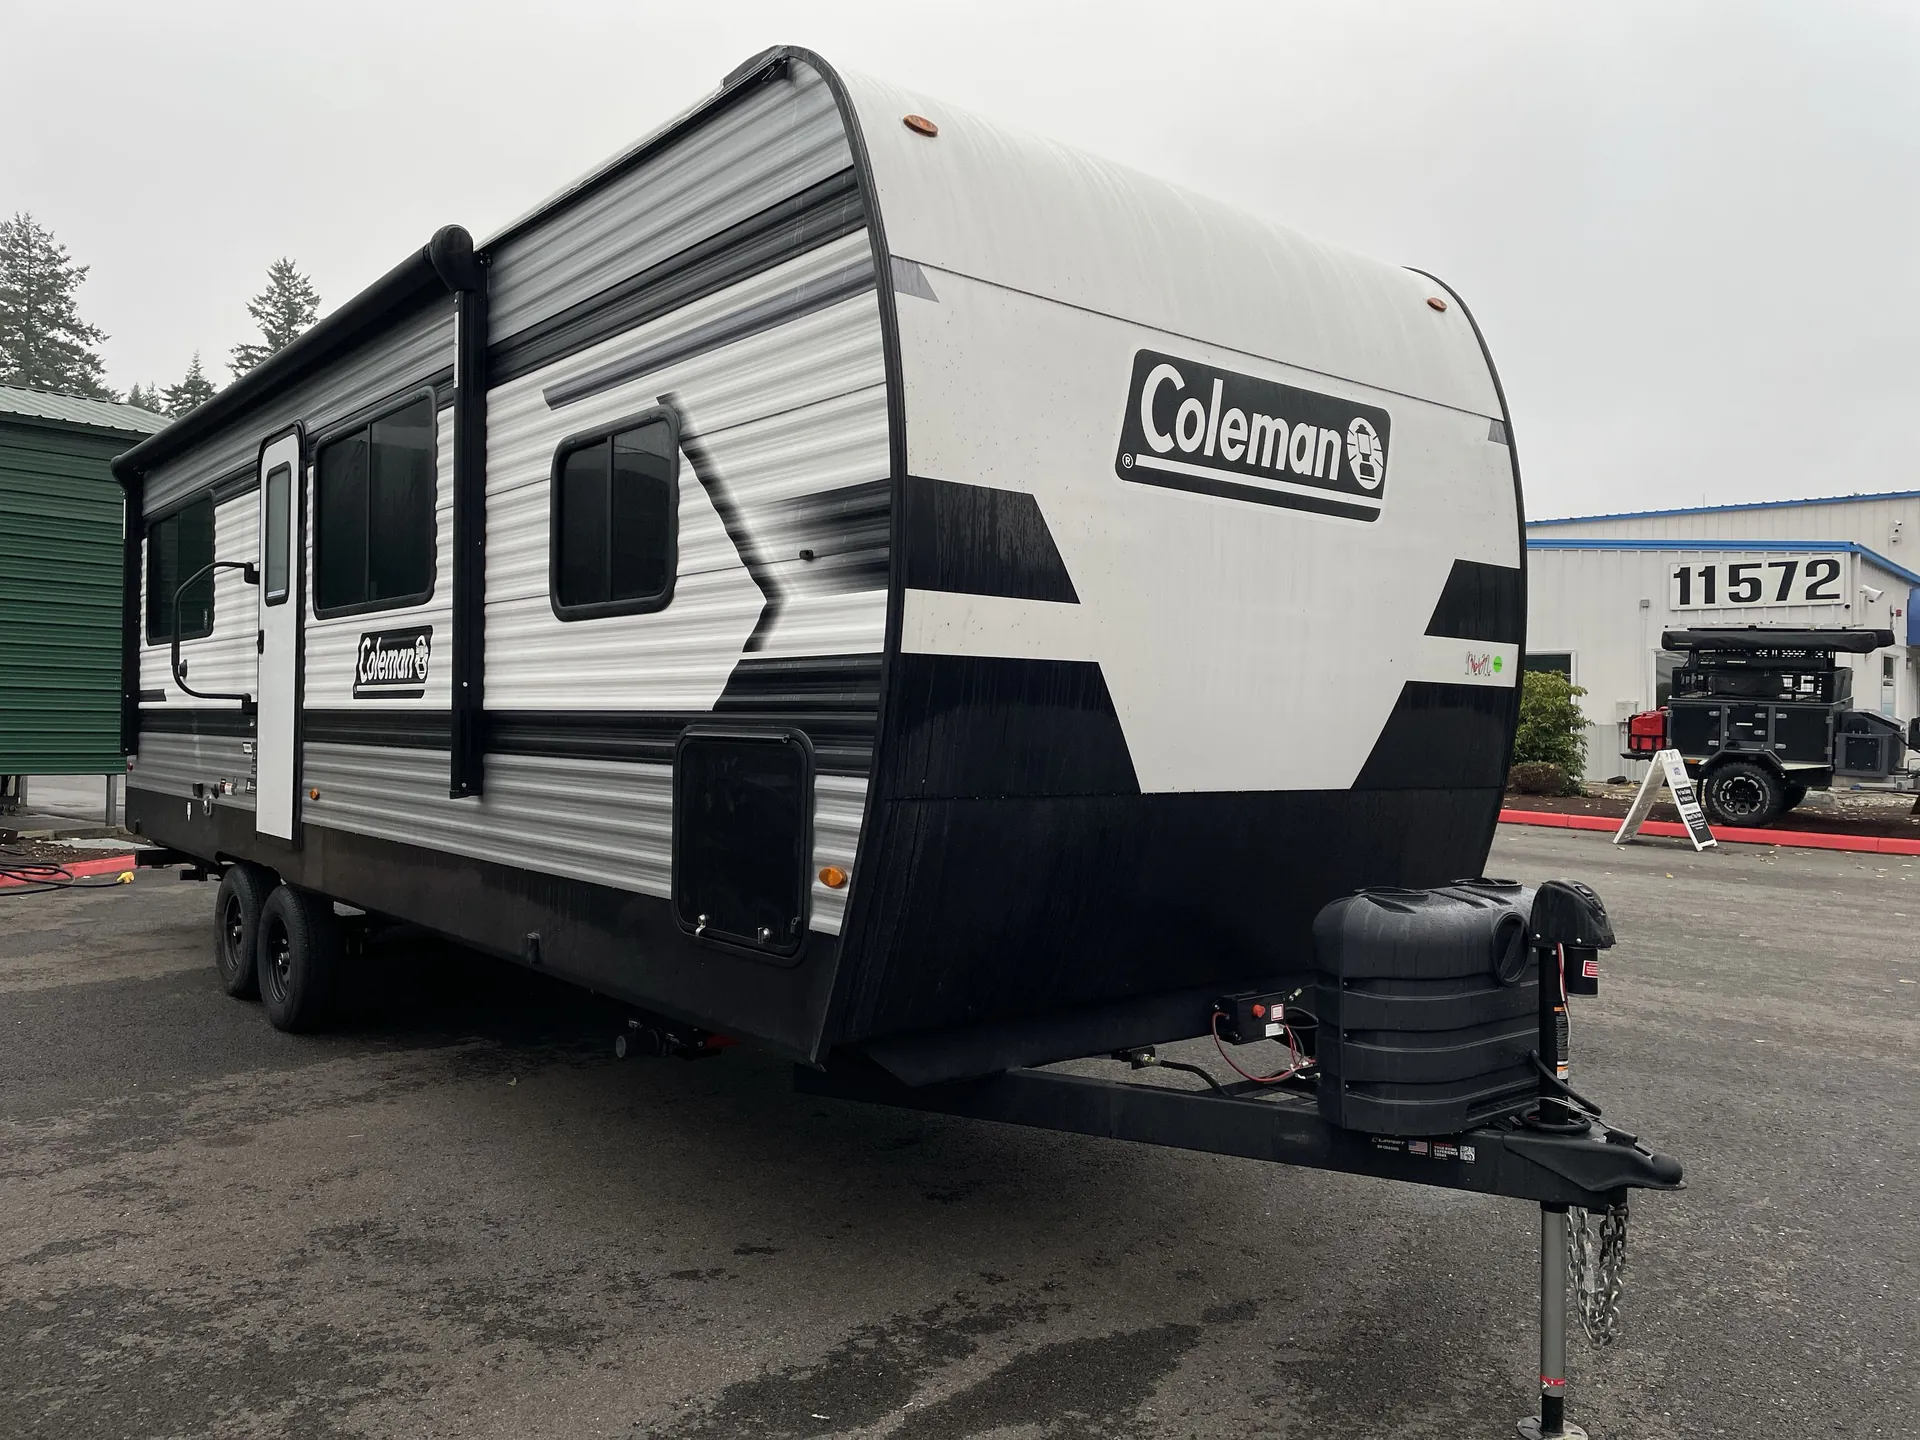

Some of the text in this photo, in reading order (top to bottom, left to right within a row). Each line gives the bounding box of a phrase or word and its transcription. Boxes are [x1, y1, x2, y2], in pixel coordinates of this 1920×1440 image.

[1140, 363, 1342, 481] Coleman
[1673, 559, 1841, 606] 11572
[359, 637, 415, 684] Coleman
